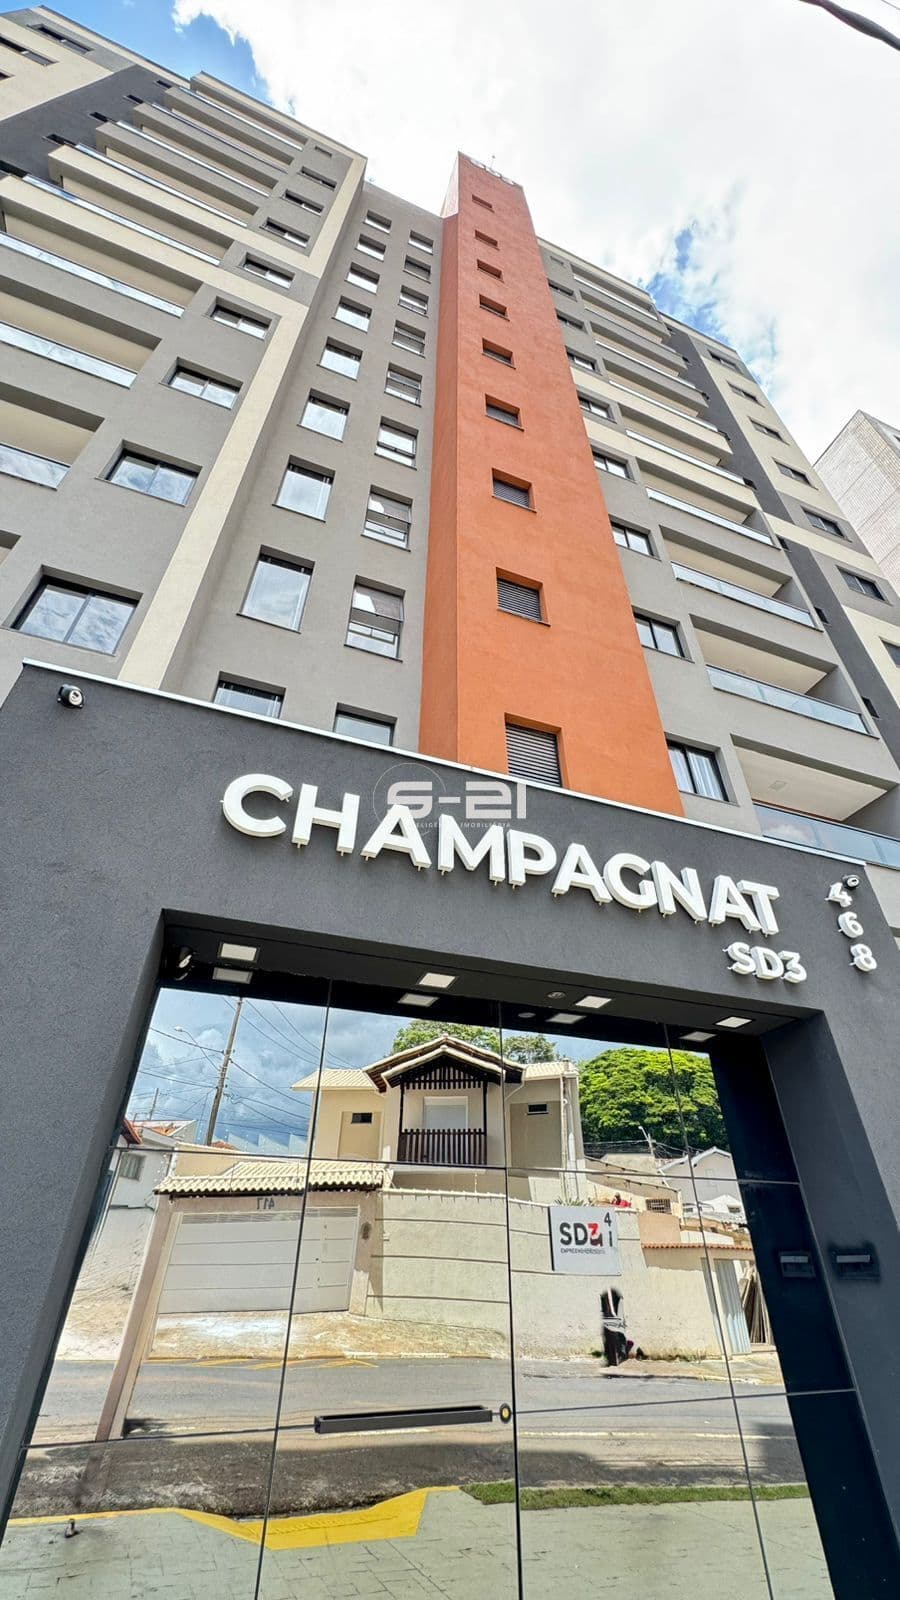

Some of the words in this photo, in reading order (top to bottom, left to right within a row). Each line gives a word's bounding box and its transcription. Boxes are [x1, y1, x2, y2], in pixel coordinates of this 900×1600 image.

[222, 773, 780, 936] CHAMPAGNAT
[726, 941, 808, 984] SD3
[826, 882, 878, 972] 468
